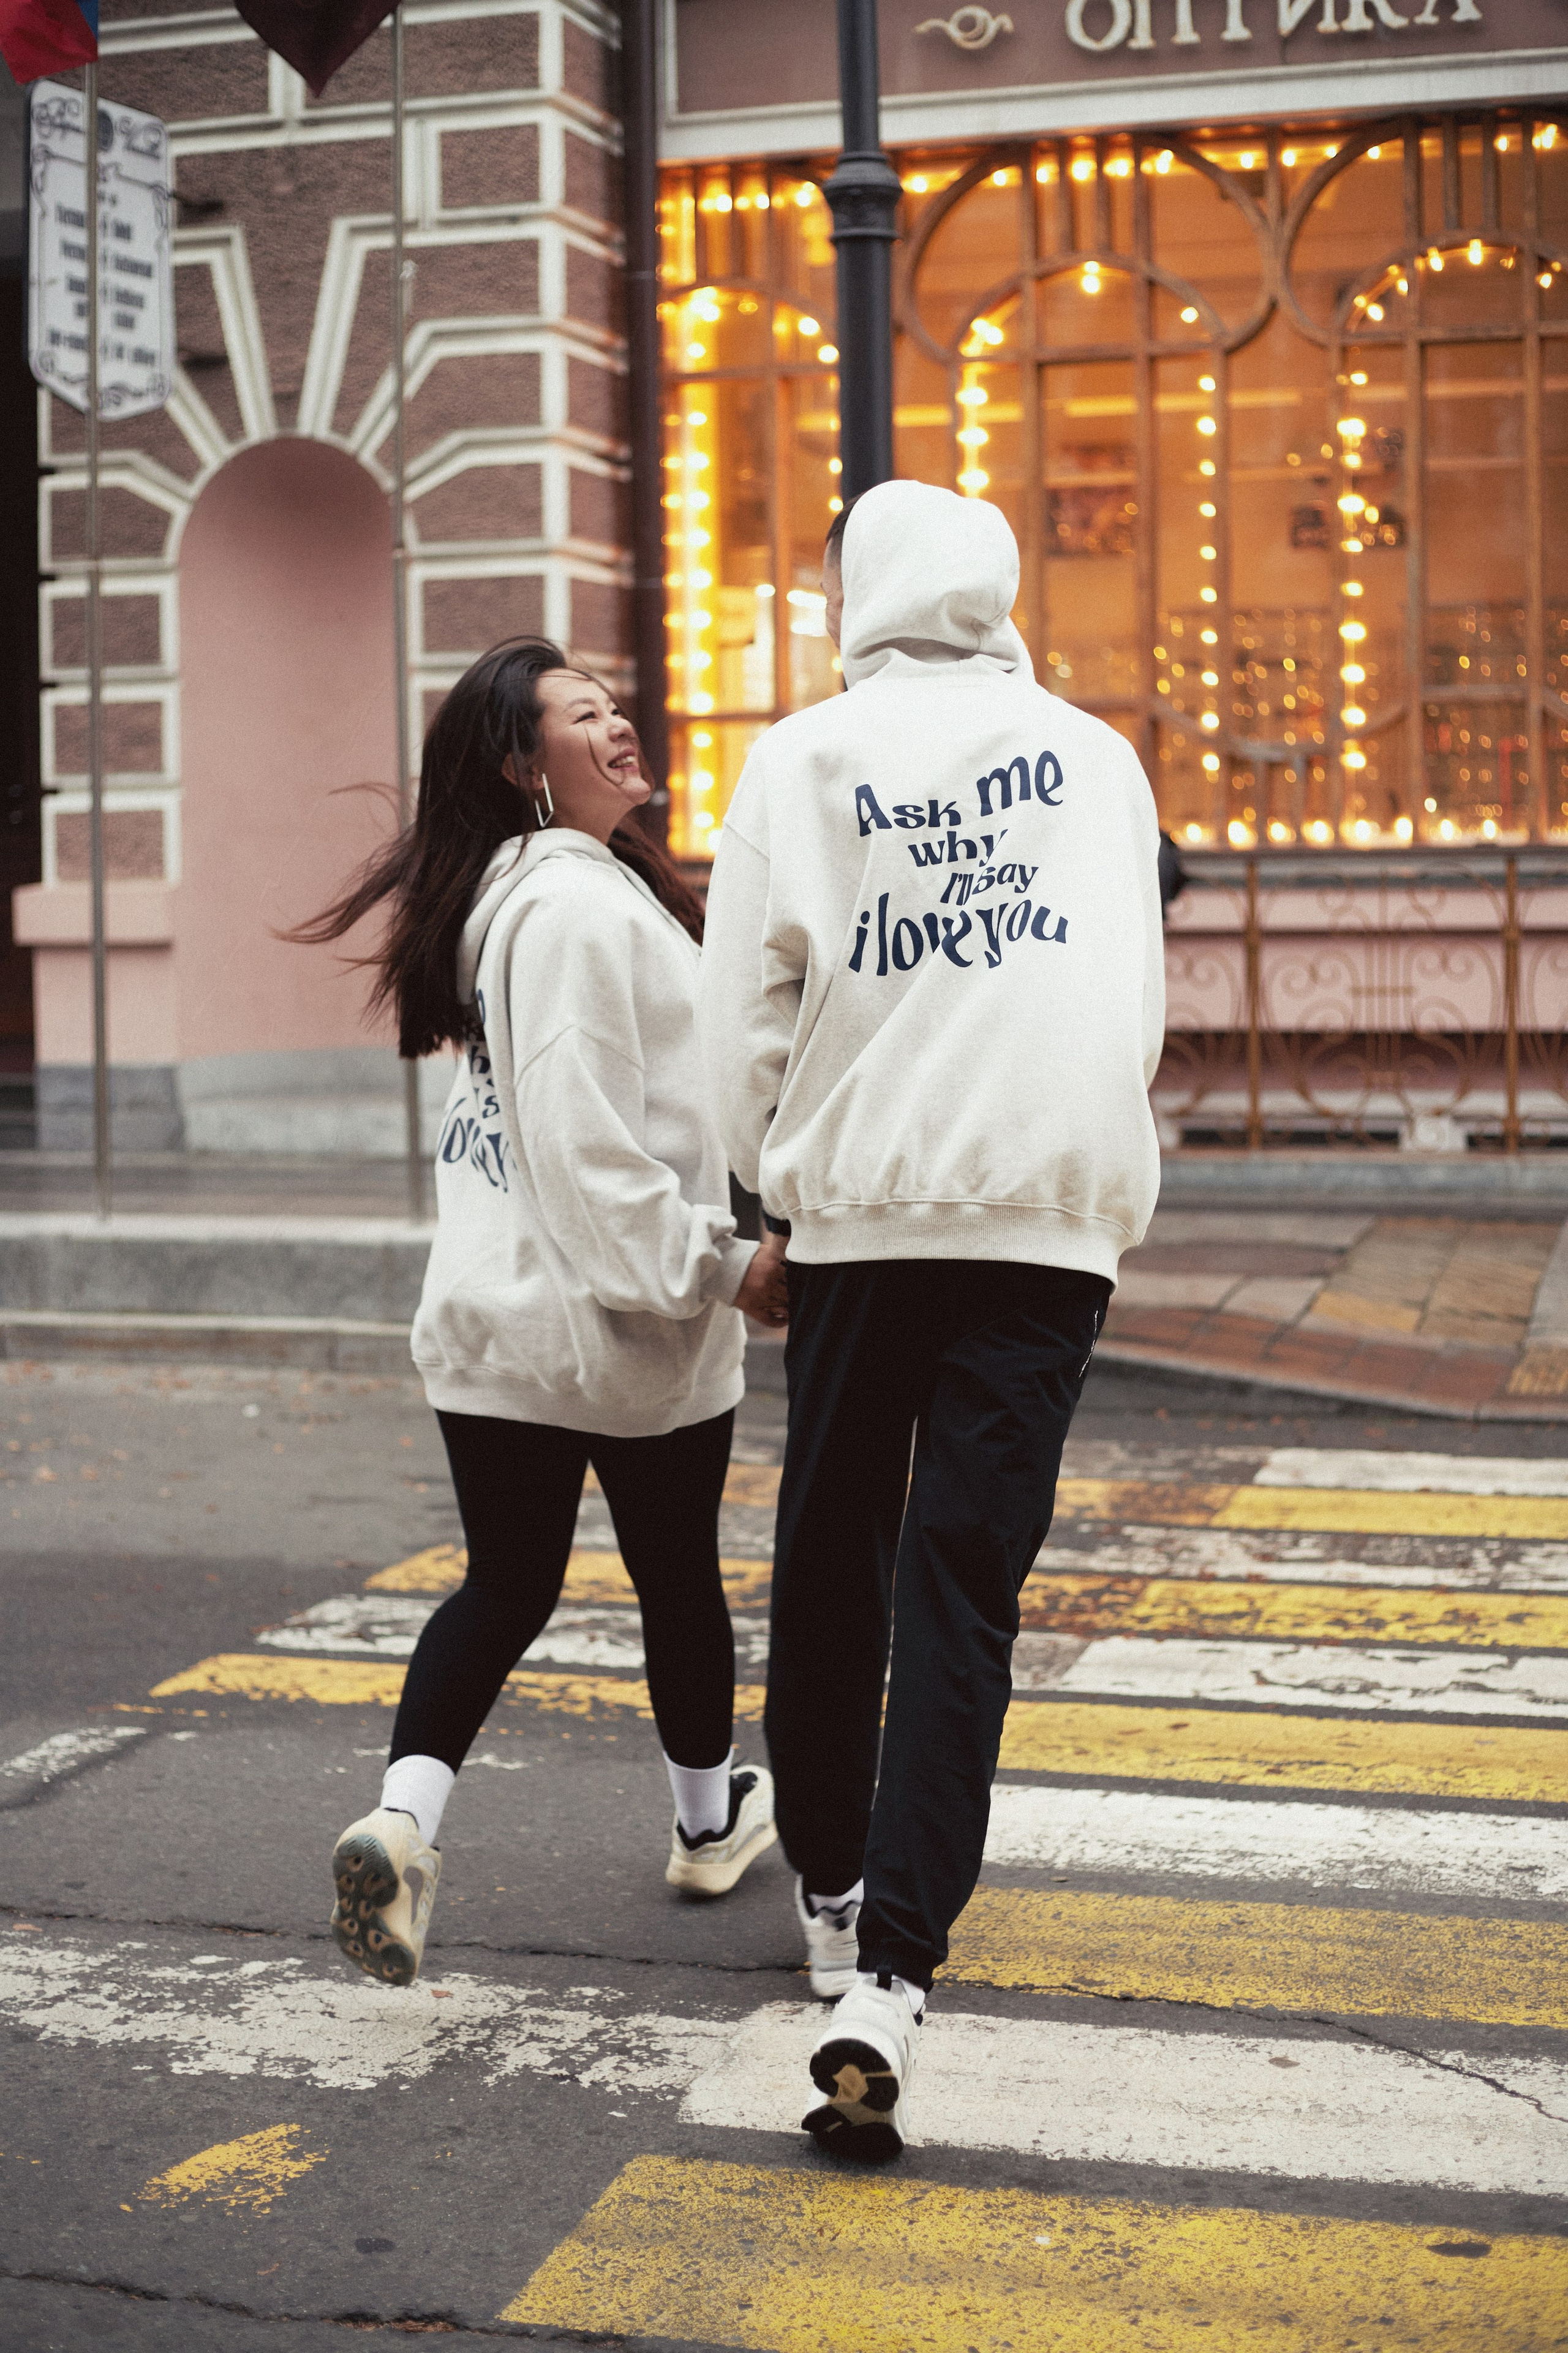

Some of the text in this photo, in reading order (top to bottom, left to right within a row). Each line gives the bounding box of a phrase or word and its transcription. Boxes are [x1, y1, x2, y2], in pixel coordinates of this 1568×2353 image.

[855, 750, 1064, 837] Ask me
[908, 829, 1008, 867] why
[971, 863, 1039, 894] say
[876, 893, 973, 976] love
[975, 899, 1068, 969] you
